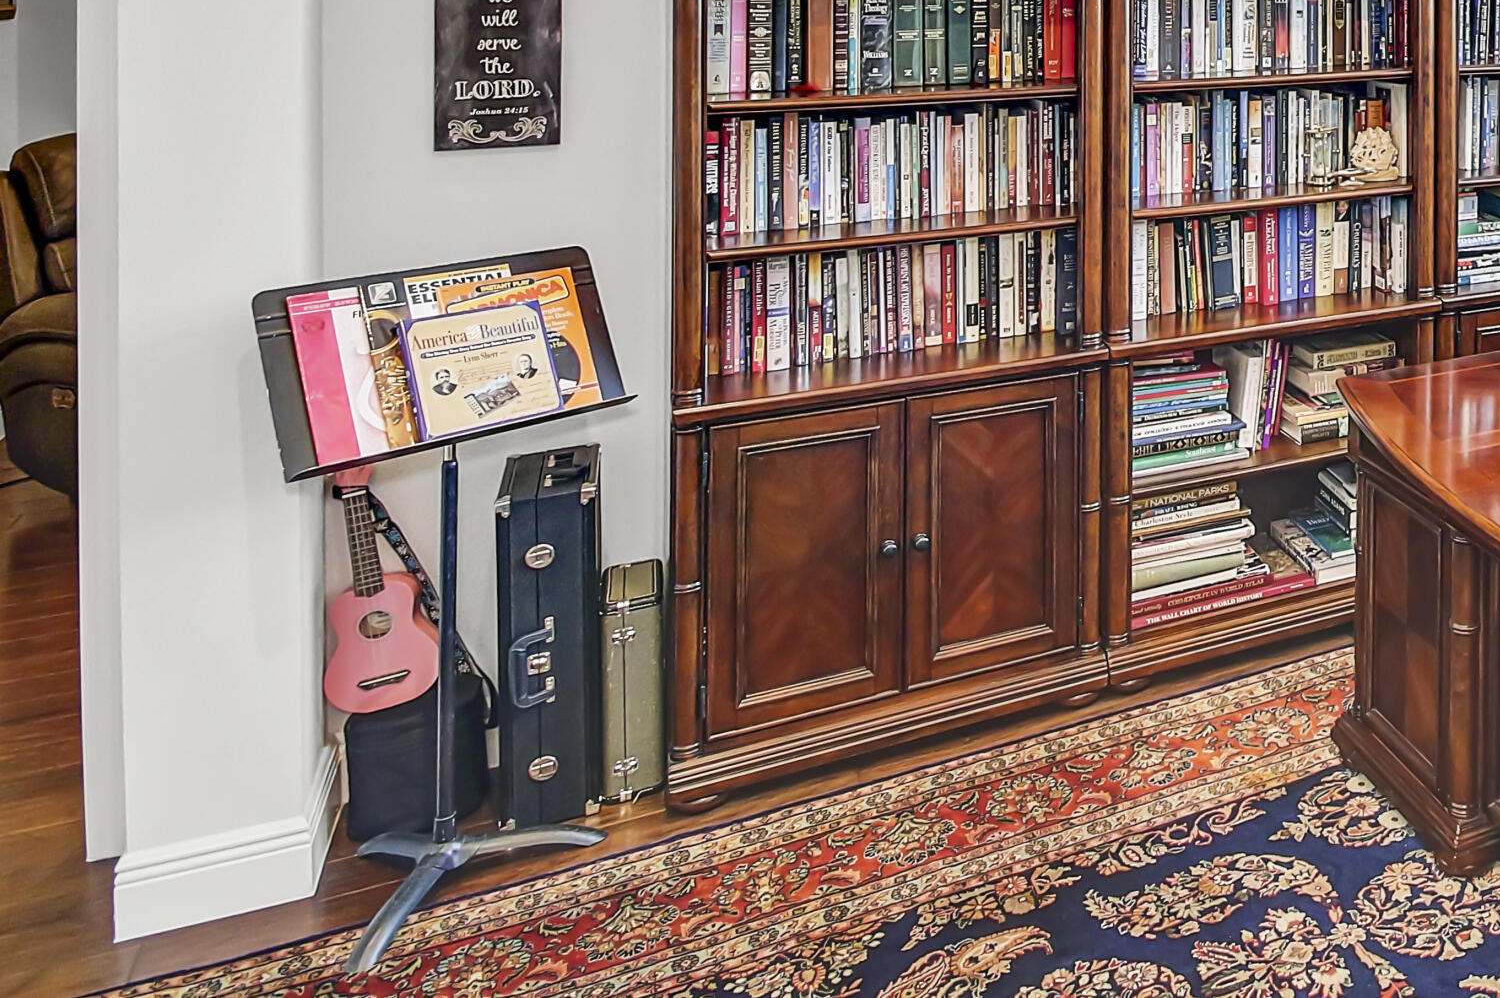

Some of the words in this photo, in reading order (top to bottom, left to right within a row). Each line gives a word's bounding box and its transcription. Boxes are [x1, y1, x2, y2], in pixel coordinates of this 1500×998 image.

[481, 9, 519, 27] will
[864, 4, 889, 14] Theology
[477, 37, 522, 51] serve
[479, 57, 514, 75] the
[469, 107, 503, 116] Joshua
[504, 106, 529, 114] 24:15
[706, 159, 719, 194] WITNESS
[921, 187, 930, 212] JOYNER
[1303, 243, 1313, 281] AMERICA
[1322, 242, 1331, 280] AMERICA
[513, 279, 530, 288] PLAY
[901, 283, 909, 292] MY
[901, 292, 910, 325] EXPRESSION
[412, 330, 468, 351] America
[480, 316, 540, 339] Beautiful
[1150, 491, 1196, 507] NATIONAL
[1198, 484, 1230, 498] PARKS
[1176, 502, 1198, 511] RISING
[1134, 516, 1173, 527] Charleston
[1175, 511, 1193, 520] Style
[1167, 590, 1219, 606] COSMOPOLITAN
[1220, 583, 1244, 594] WORLD
[1146, 616, 1160, 624] THE
[1161, 612, 1179, 622] WALL
[1179, 607, 1202, 617] CHART
[1202, 604, 1212, 612] OF
[1212, 598, 1236, 608] WORLD
[1236, 592, 1264, 603] HISTORY
